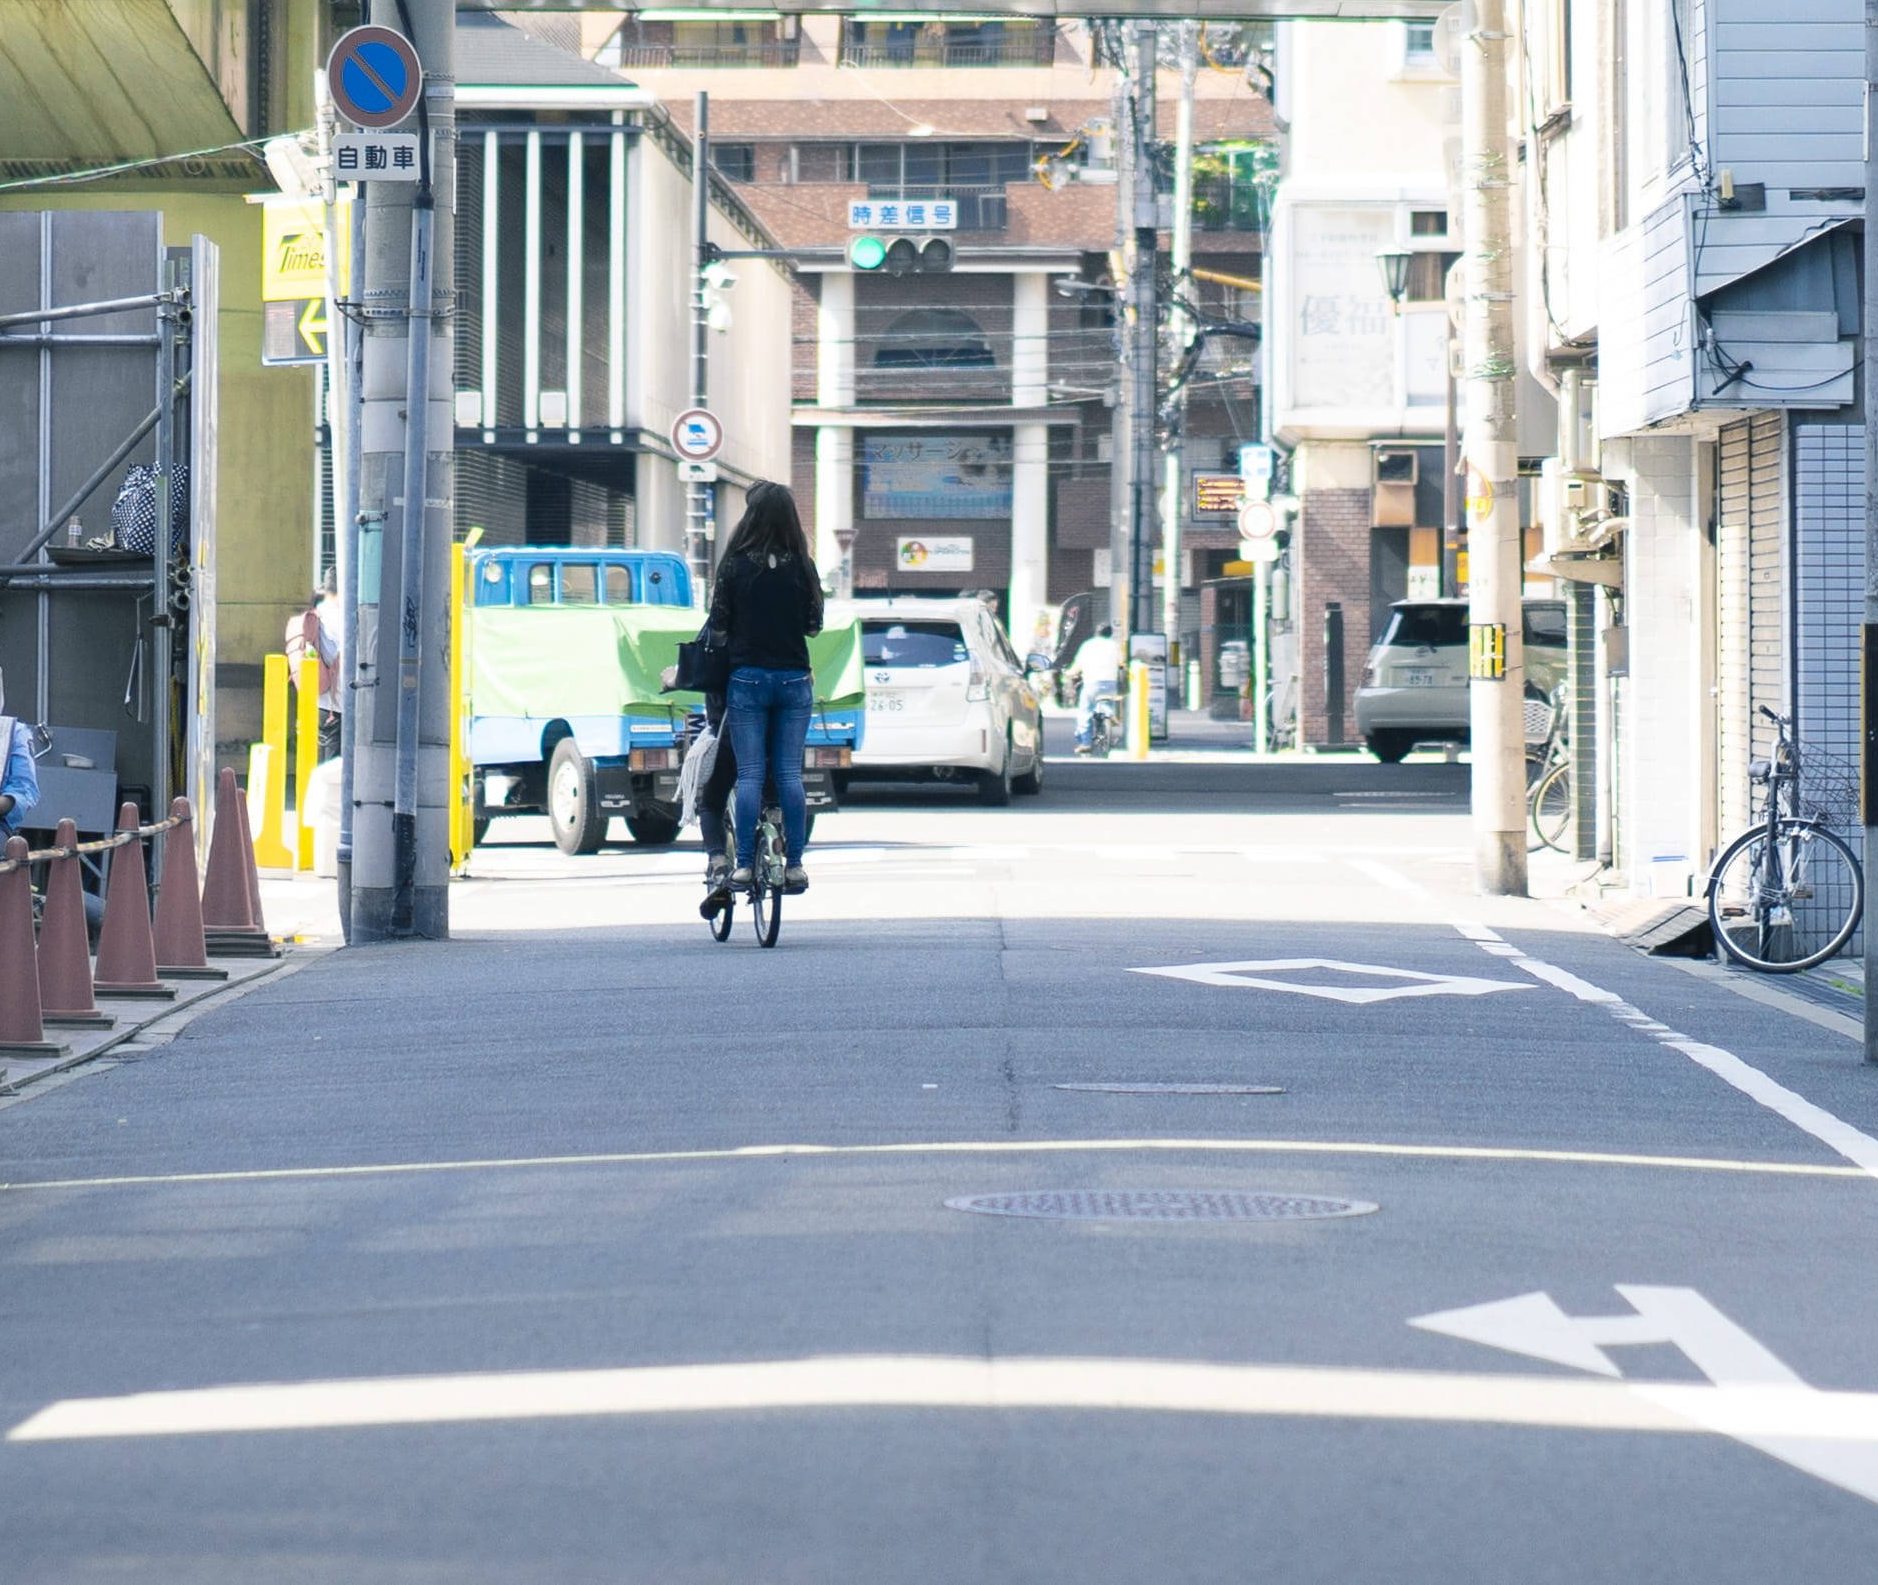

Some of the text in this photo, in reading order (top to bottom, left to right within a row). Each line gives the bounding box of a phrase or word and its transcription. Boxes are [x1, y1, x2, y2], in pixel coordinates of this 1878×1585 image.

[337, 145, 415, 170] 自動車
[852, 205, 952, 224] 時差信号
